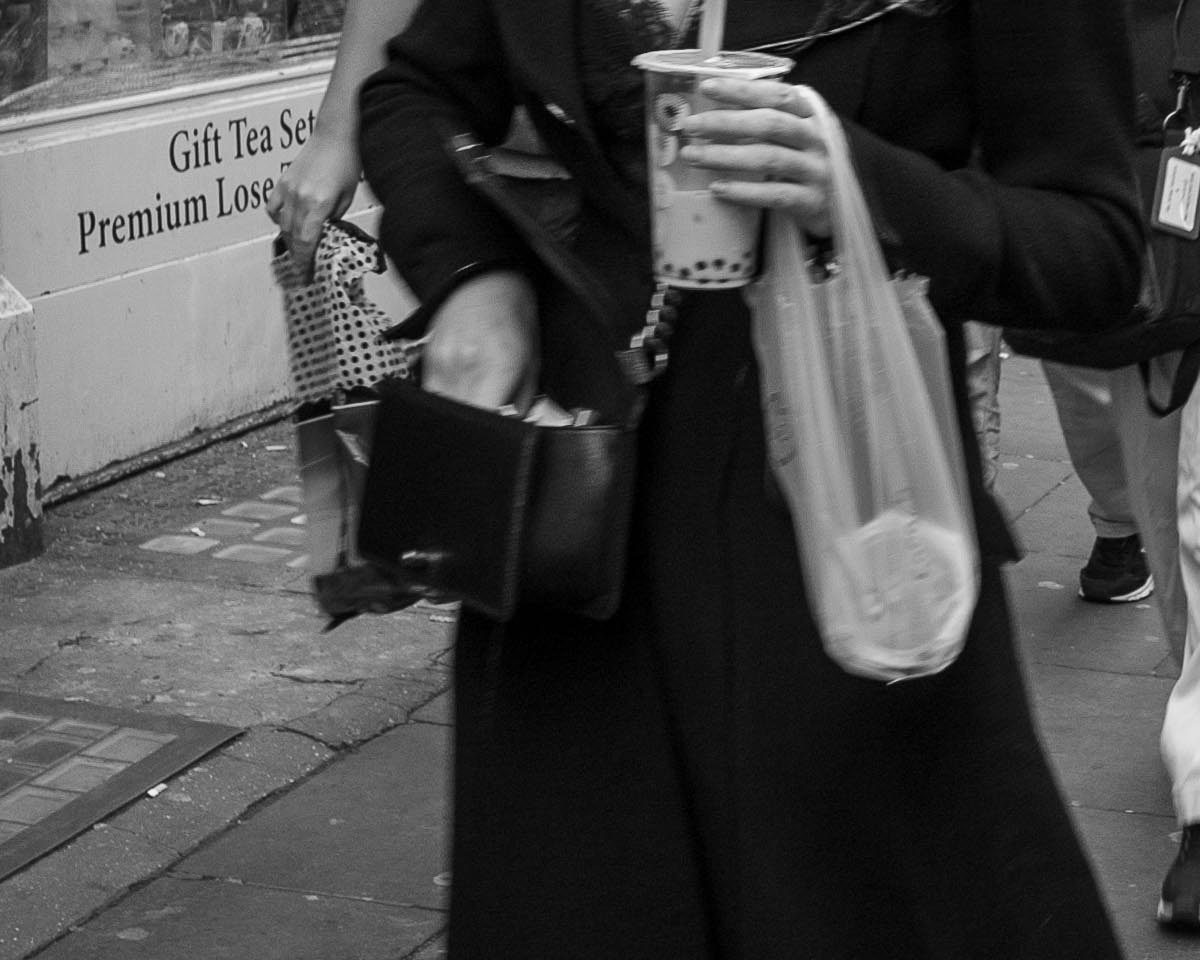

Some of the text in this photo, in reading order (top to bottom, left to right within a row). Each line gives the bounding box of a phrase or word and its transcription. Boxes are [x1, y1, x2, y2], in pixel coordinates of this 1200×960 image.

[169, 108, 316, 173] Gift Tea Set
[77, 176, 275, 256] Premium Lose
